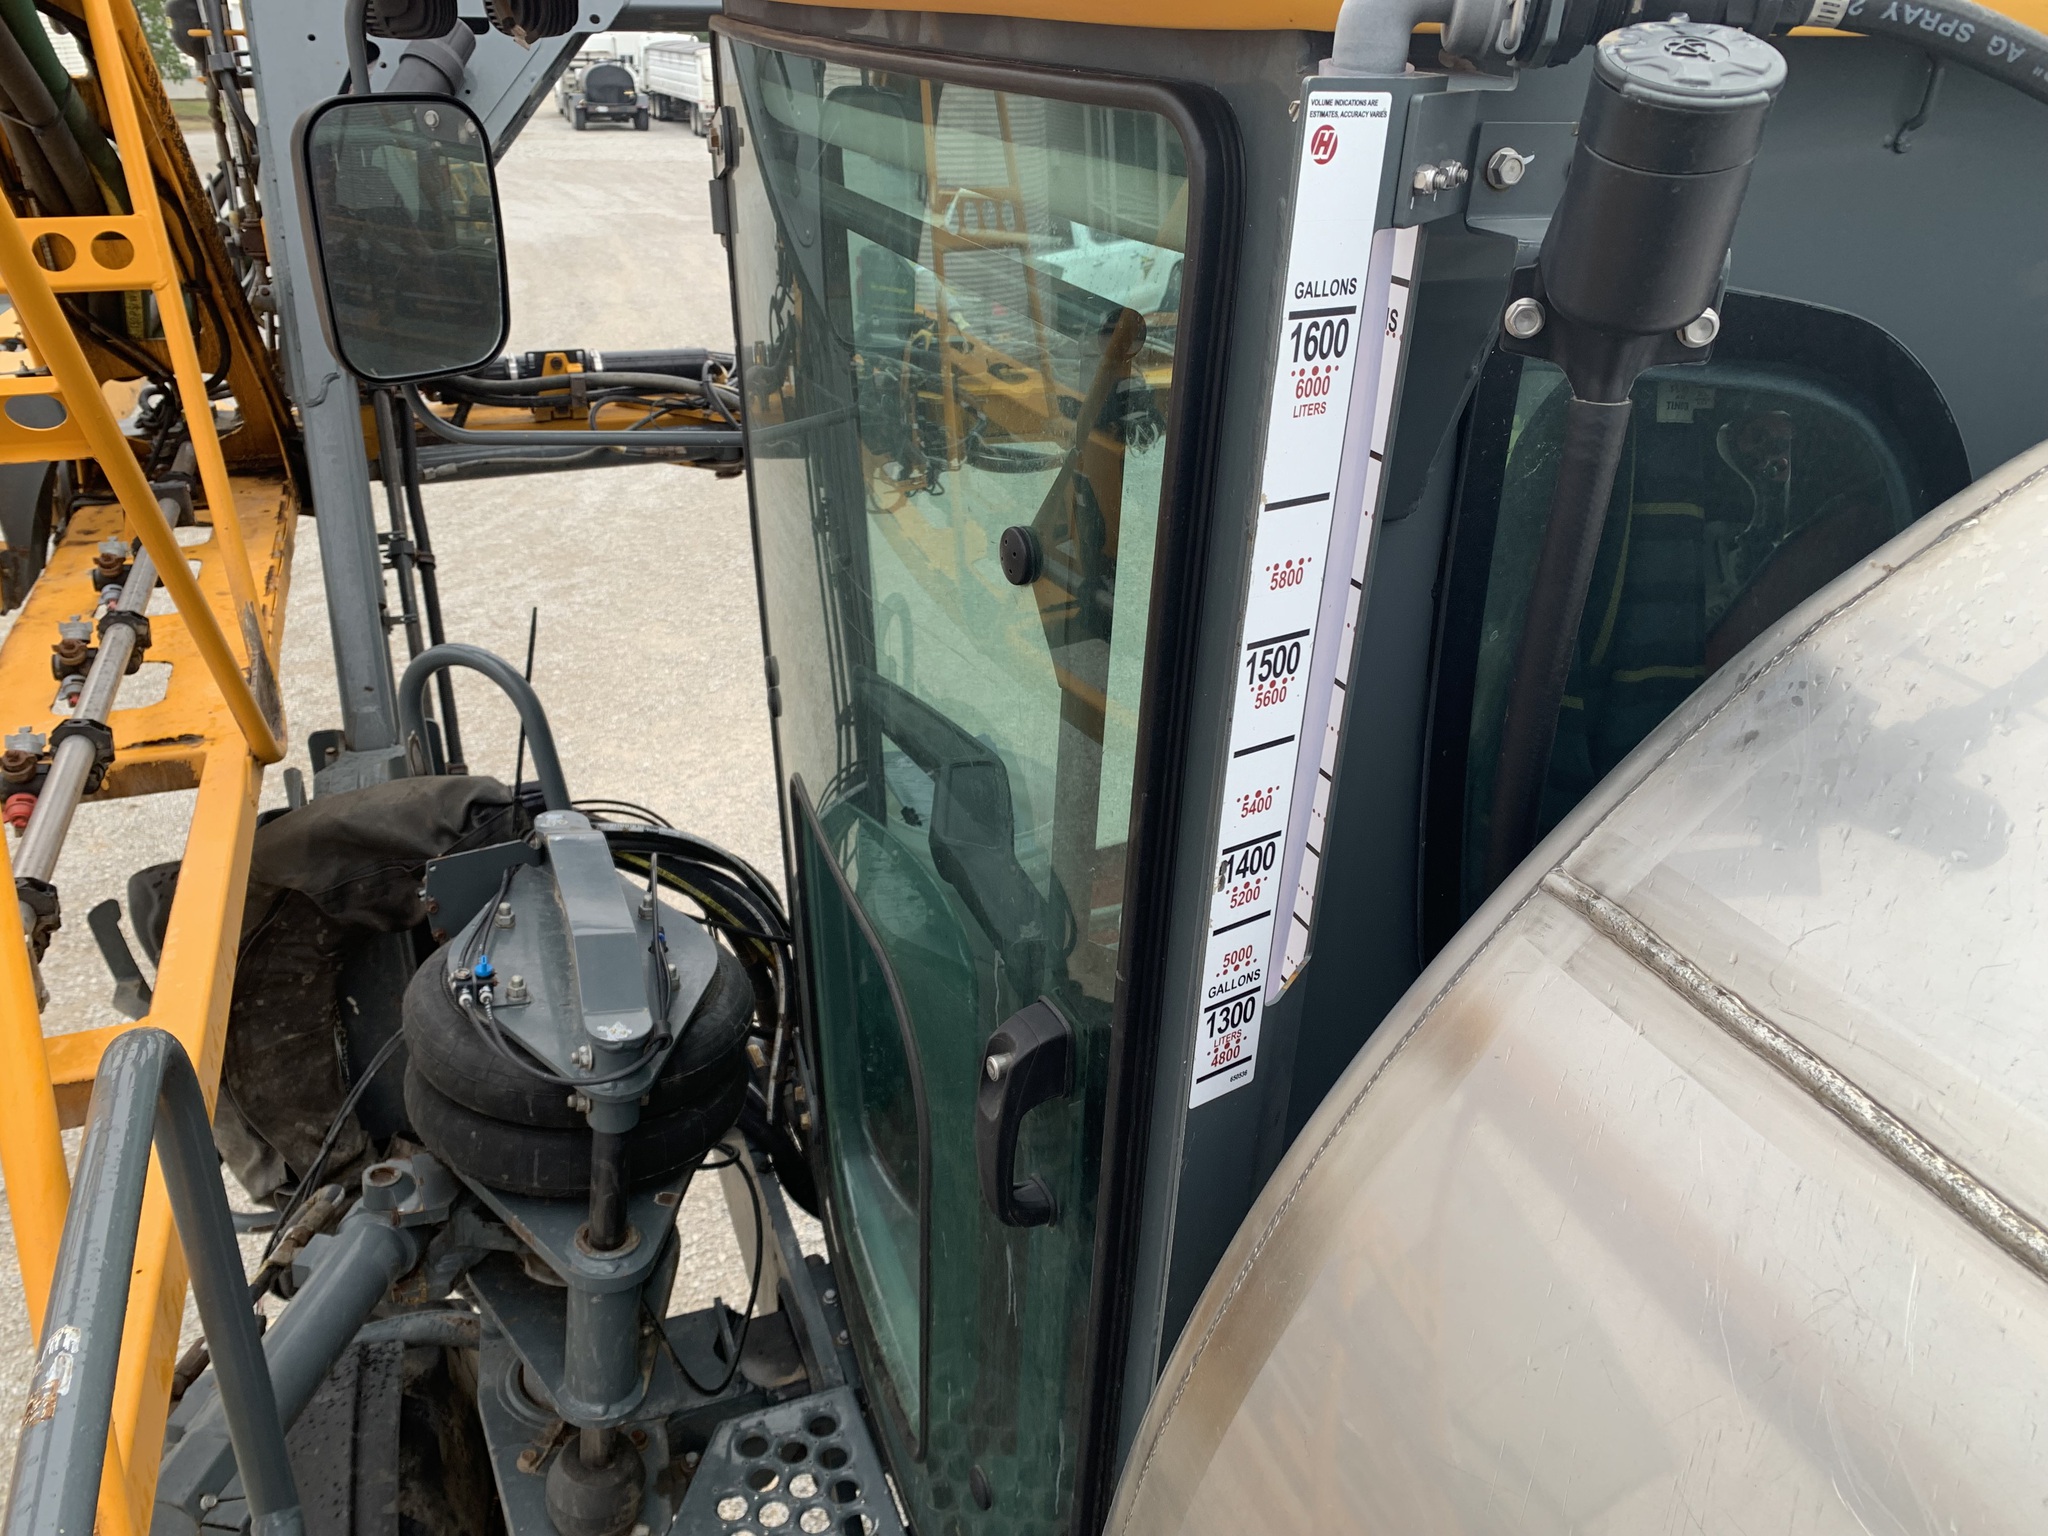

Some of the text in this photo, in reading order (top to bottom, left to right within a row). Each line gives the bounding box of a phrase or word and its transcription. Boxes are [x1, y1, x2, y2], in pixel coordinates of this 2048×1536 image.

[1879, 0, 1976, 43] SPRAY
[1986, 33, 2026, 63] AG
[1309, 110, 1388, 119] ESTIMATES, ACCURACY VARIES
[1310, 98, 1379, 107] VOLUME INDICATIONS ARE
[1294, 277, 1358, 300] GALLONS
[1290, 317, 1350, 363] 1600
[1295, 374, 1331, 400] 6000
[1292, 401, 1327, 419] LITERS
[1269, 566, 1304, 591] 5800
[1246, 640, 1301, 685] 1500
[1254, 685, 1287, 710] 5600
[1240, 794, 1273, 819] 5400
[1225, 840, 1276, 884] 1400
[1229, 885, 1261, 909] 5200
[1222, 944, 1253, 968] 5000
[1208, 968, 1261, 999] GALLONS
[1206, 996, 1256, 1039] 1300
[1213, 1029, 1243, 1048] LITERS
[1210, 1045, 1241, 1068] 4800
